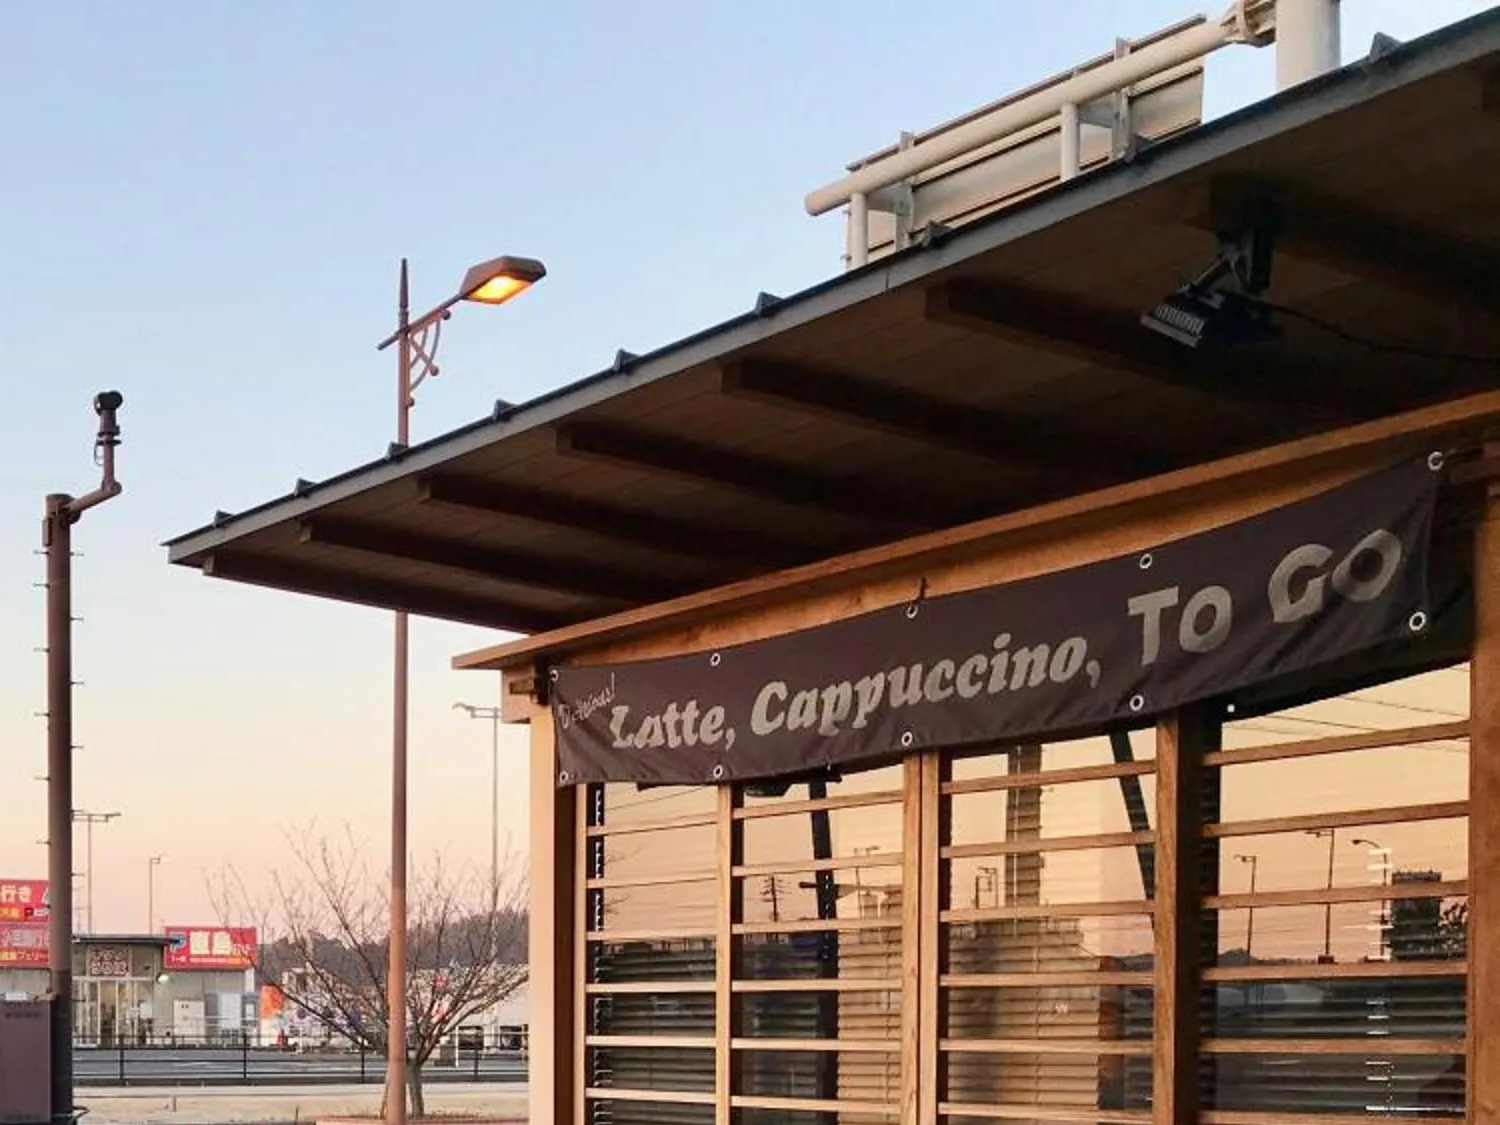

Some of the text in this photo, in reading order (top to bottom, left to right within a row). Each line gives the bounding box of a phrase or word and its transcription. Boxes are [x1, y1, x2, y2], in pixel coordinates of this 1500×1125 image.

[610, 528, 1402, 751] Latte, Cappuccino, TO GO
